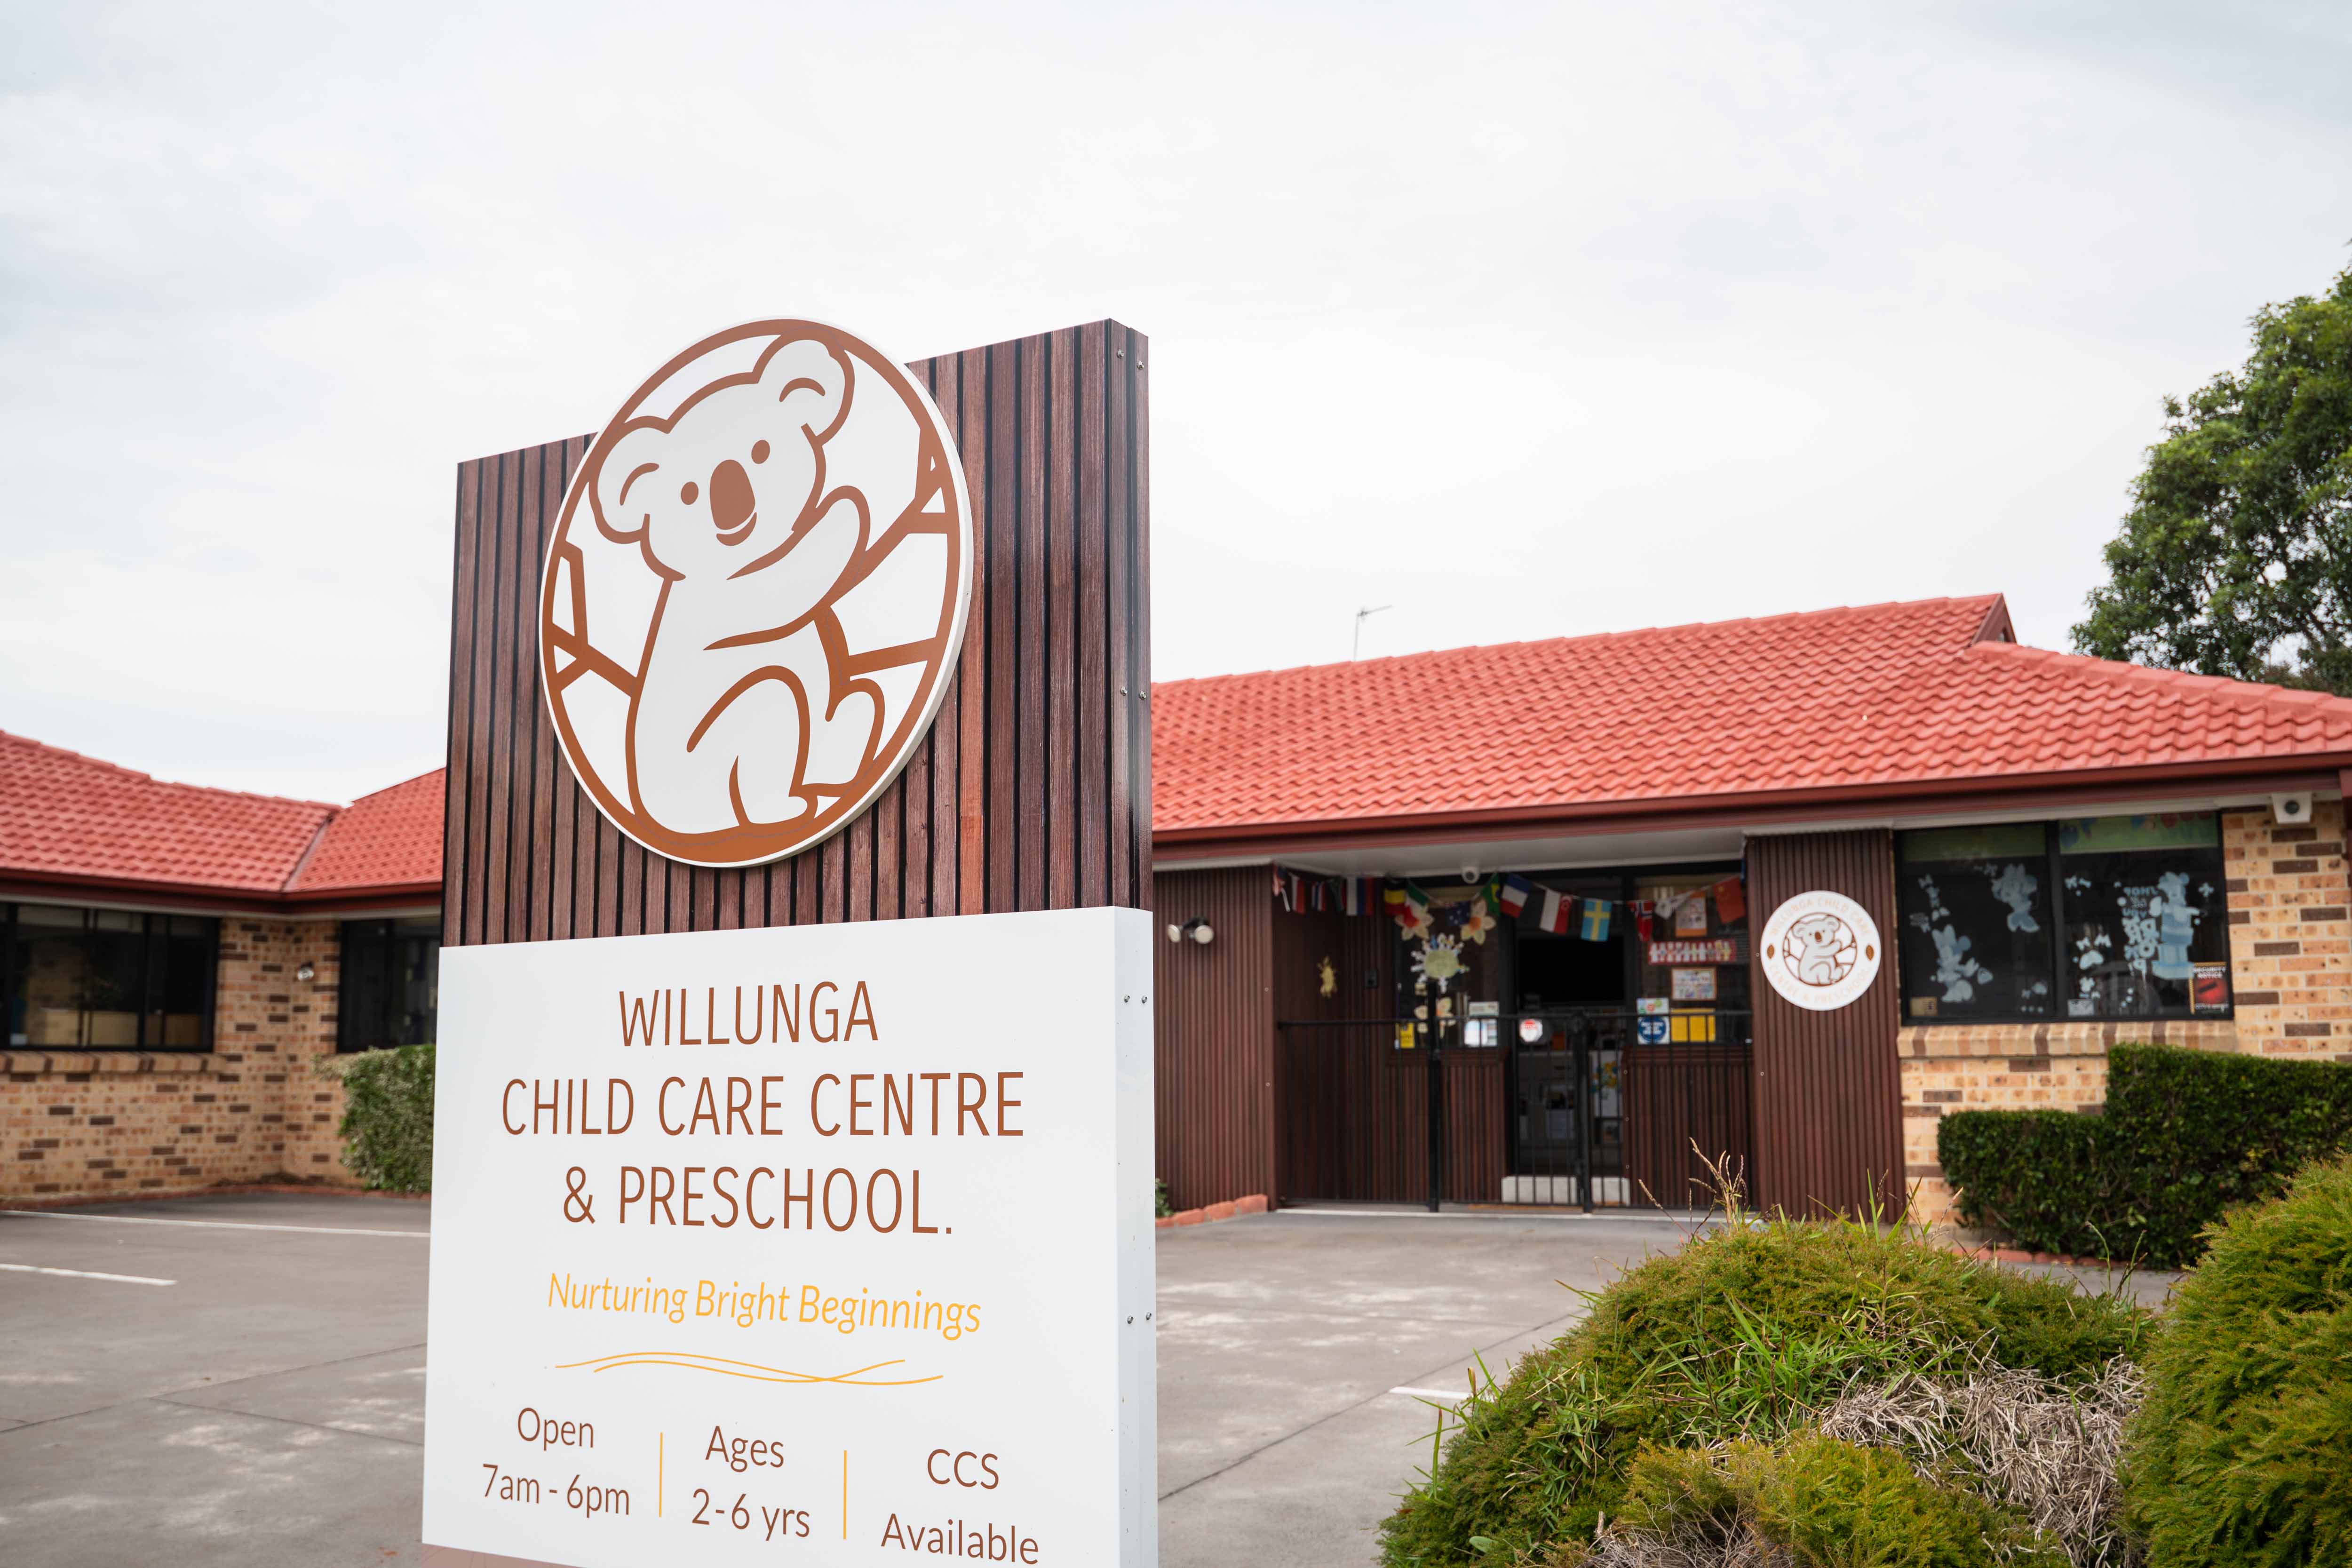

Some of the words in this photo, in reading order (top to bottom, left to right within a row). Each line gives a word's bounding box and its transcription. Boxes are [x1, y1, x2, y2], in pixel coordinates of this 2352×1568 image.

[1817, 895, 1850, 914] CHILD
[618, 980, 879, 1047] WILLUNGA
[502, 1078, 635, 1136] CHILD
[659, 1076, 784, 1136] CARE
[810, 1072, 1024, 1137] CENTRE
[563, 1166, 595, 1224] &
[619, 1166, 953, 1234] PRESCHOOL.
[548, 1272, 689, 1324] Nurturing
[695, 1278, 791, 1329] Bright
[798, 1284, 982, 1341] Beginnings
[517, 1407, 594, 1451] Open
[705, 1426, 783, 1473] Ages
[483, 1464, 540, 1504] 7am
[567, 1475, 629, 1518] 6pm
[927, 1449, 999, 1490] CCS
[761, 1506, 810, 1541] yrs
[881, 1512, 1039, 1565] Available
